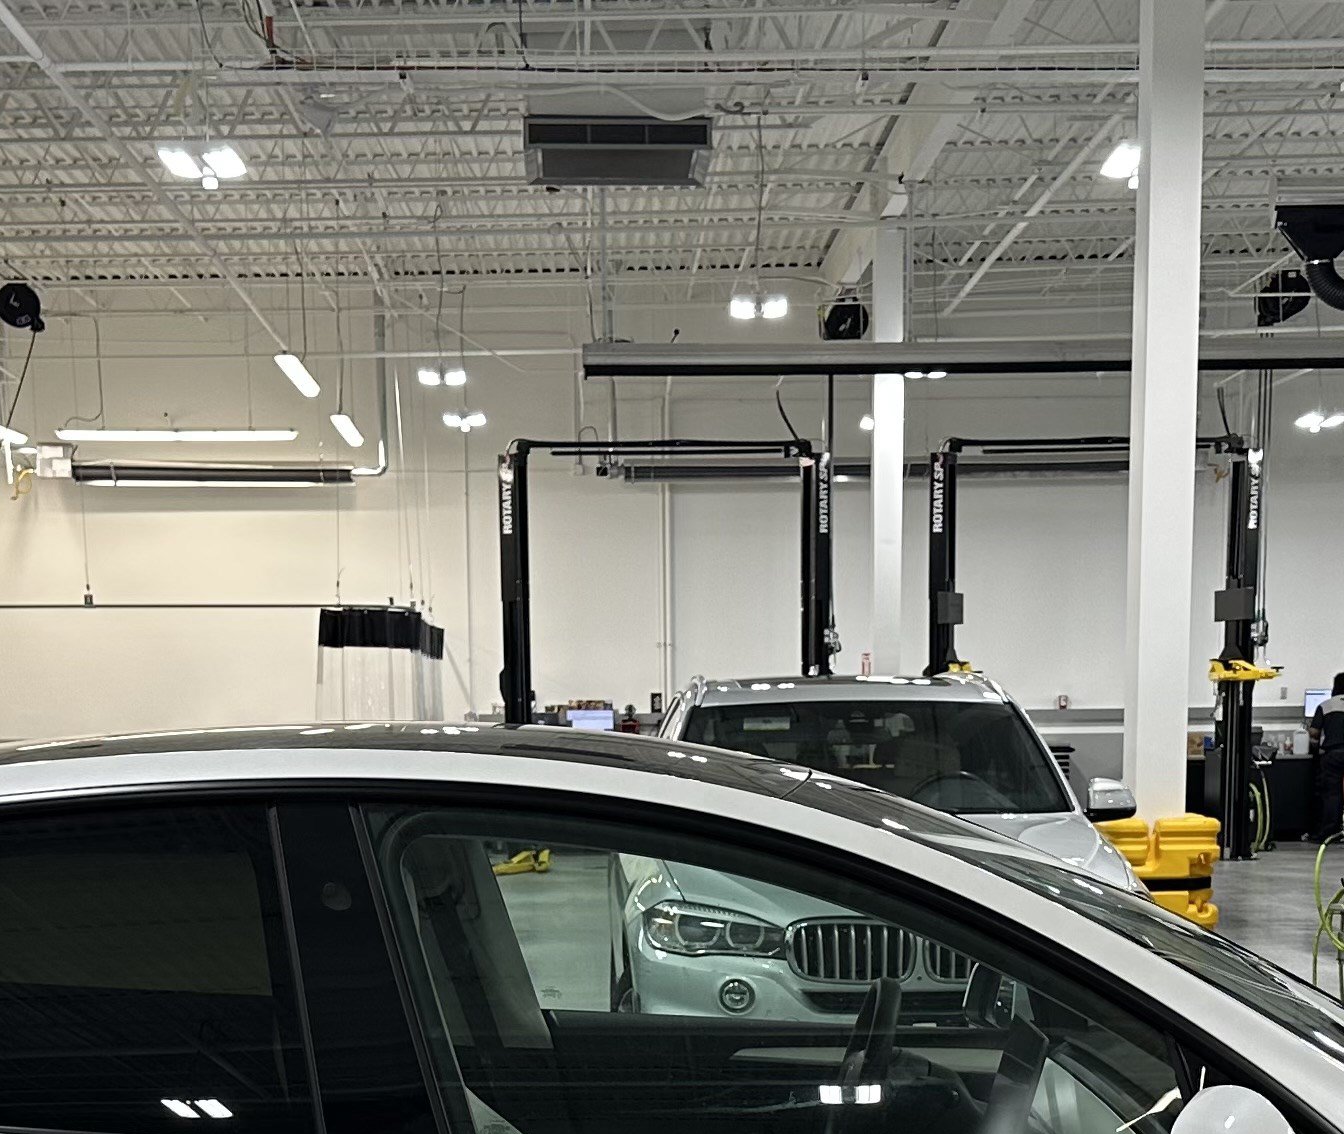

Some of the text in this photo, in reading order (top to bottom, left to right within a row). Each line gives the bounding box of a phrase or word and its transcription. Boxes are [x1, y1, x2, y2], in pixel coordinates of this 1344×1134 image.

[501, 482, 513, 535] ROTARY
[819, 481, 829, 534] ROTARY
[932, 461, 944, 533] ROTARY SP
